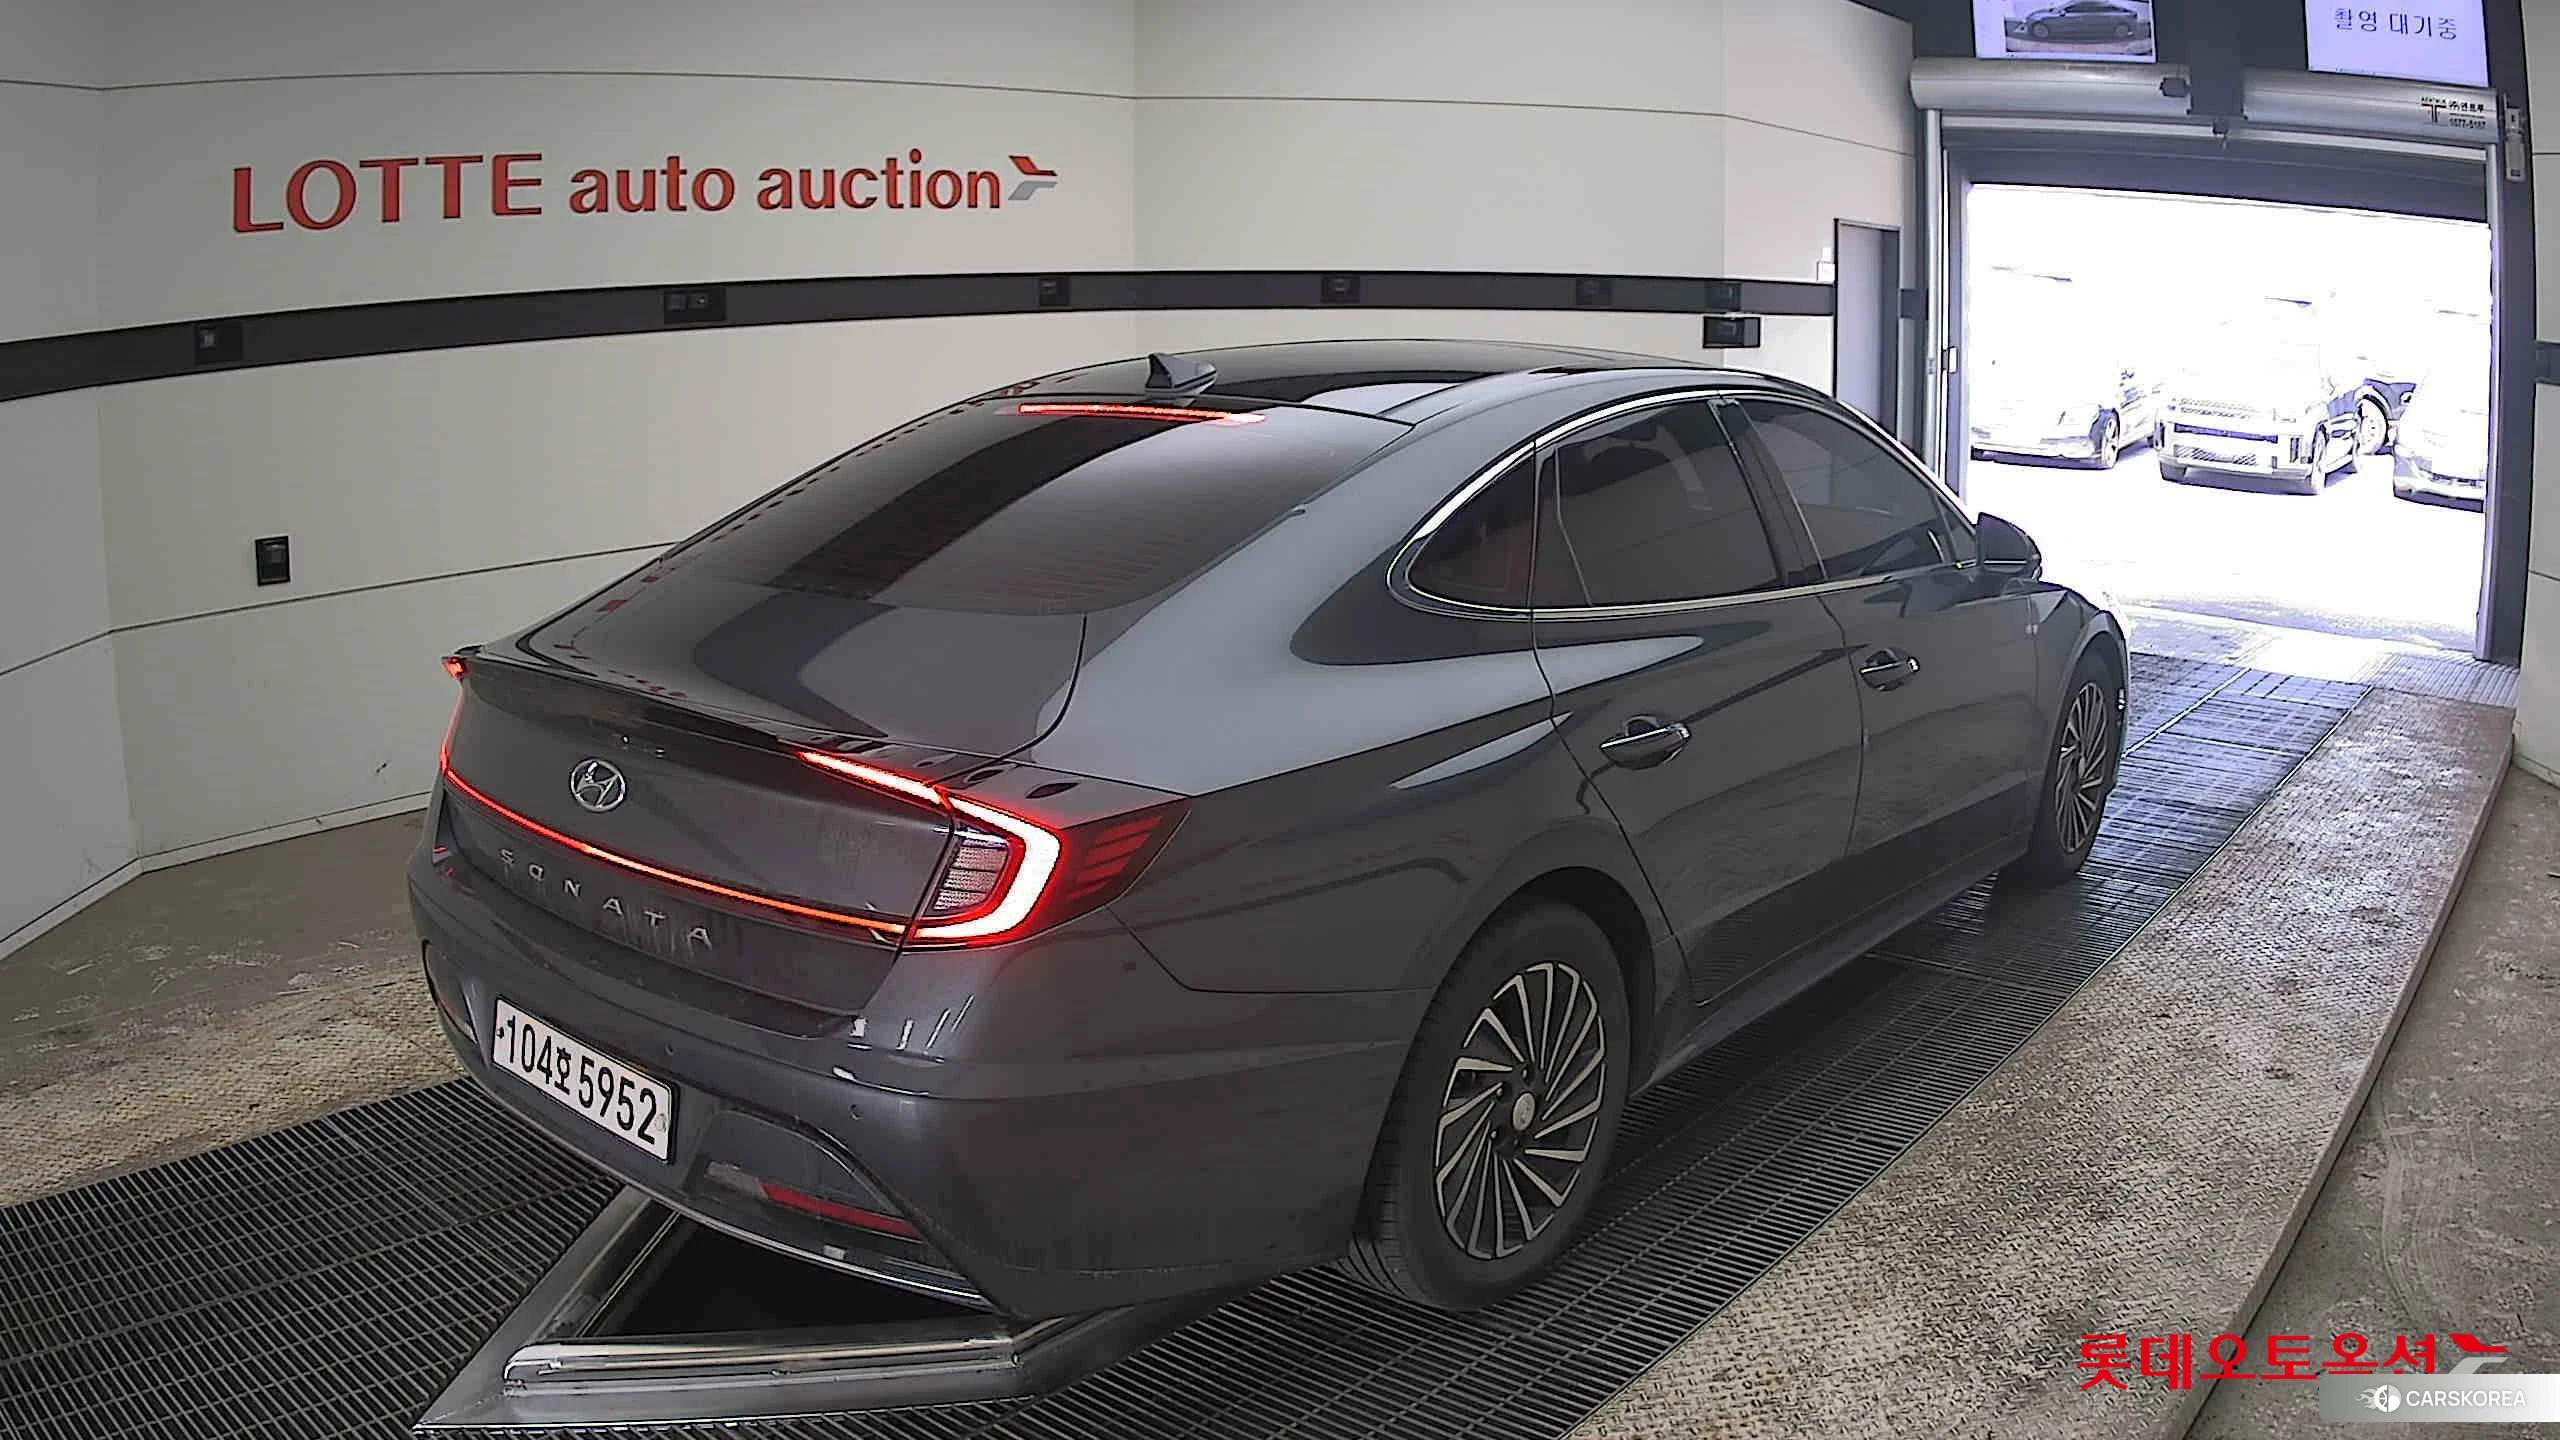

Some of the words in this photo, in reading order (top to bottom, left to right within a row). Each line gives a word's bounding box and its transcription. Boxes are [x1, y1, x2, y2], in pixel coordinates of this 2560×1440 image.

[2389, 13, 2457, 40] 대기중
[233, 153, 543, 234] LOTTE
[568, 155, 735, 214] auto
[757, 148, 1001, 211] auction
[500, 848, 713, 950] SONATA
